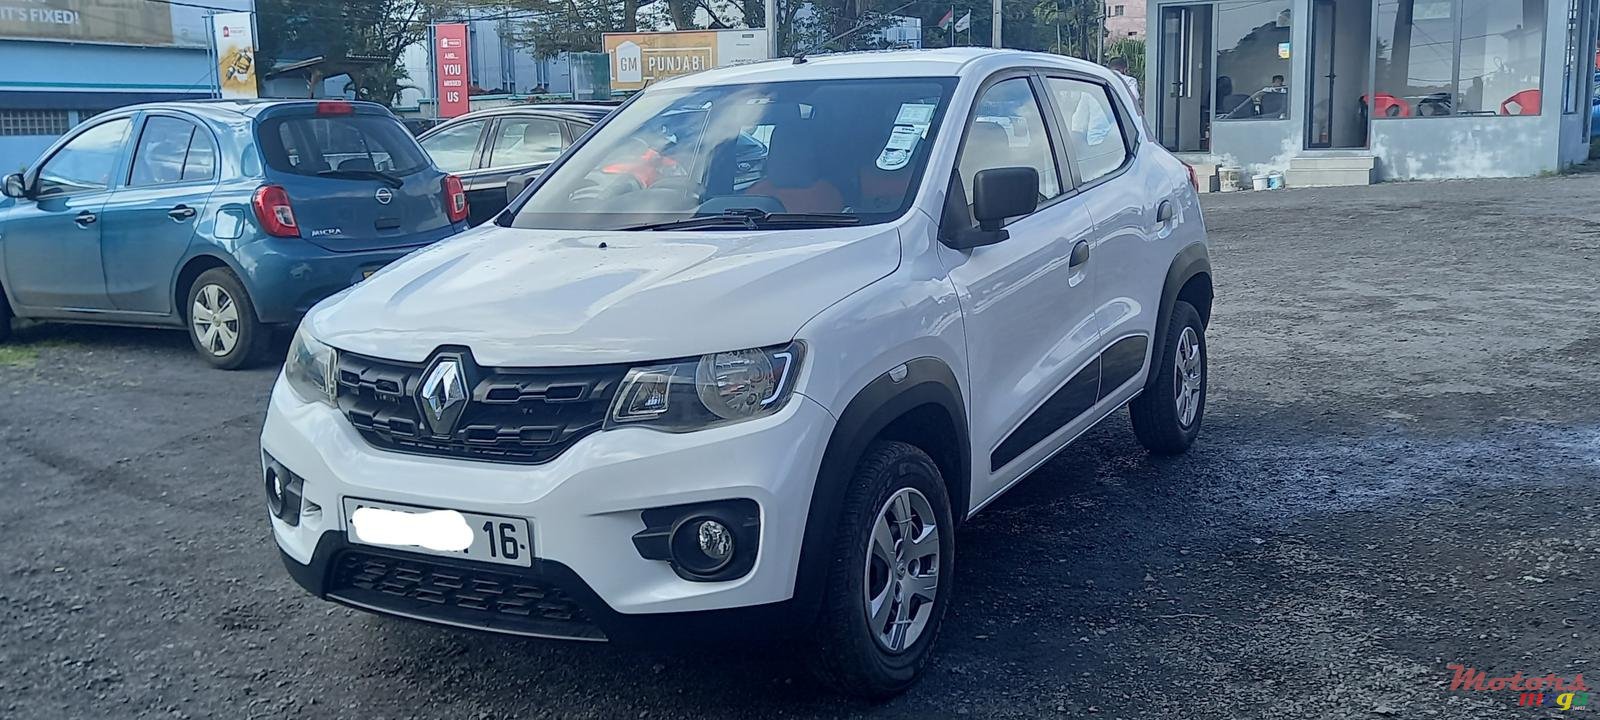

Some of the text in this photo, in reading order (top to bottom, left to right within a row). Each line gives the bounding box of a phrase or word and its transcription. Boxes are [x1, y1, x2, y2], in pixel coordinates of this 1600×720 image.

[30, 8, 80, 24] FIXED!
[443, 64, 461, 75] YOU
[620, 55, 705, 72] GM PUNJABI
[447, 92, 459, 103] US
[311, 228, 342, 237] MICRA
[482, 521, 519, 560] 16
